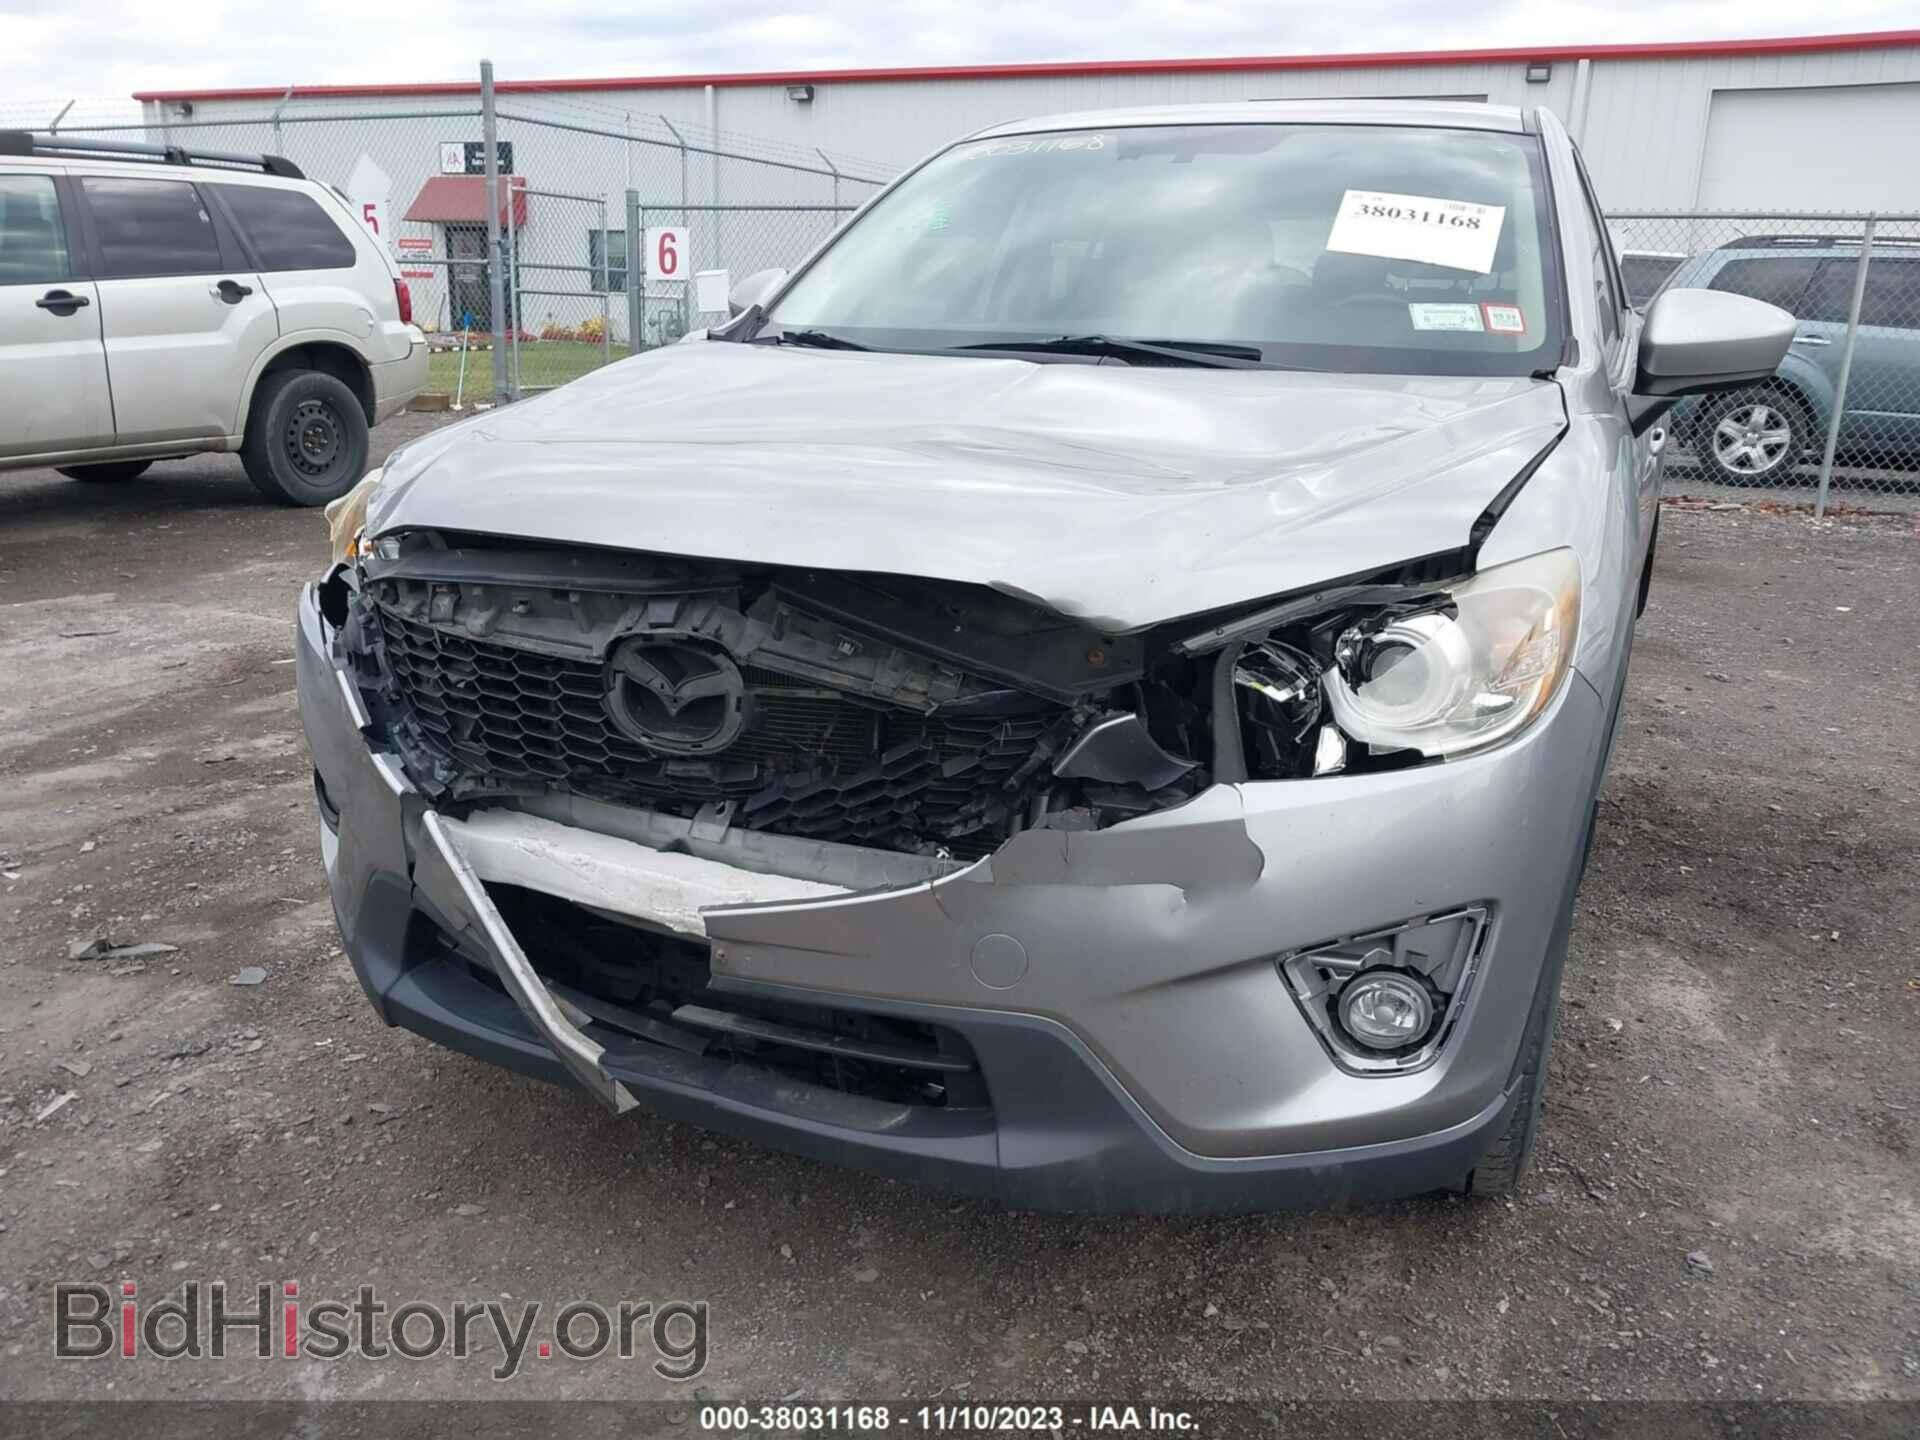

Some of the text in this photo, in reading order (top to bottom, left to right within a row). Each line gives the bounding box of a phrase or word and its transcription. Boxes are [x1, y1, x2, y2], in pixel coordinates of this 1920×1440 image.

[363, 203, 379, 235] 5
[1354, 203, 1481, 230] 38031168
[658, 232, 677, 275] 6
